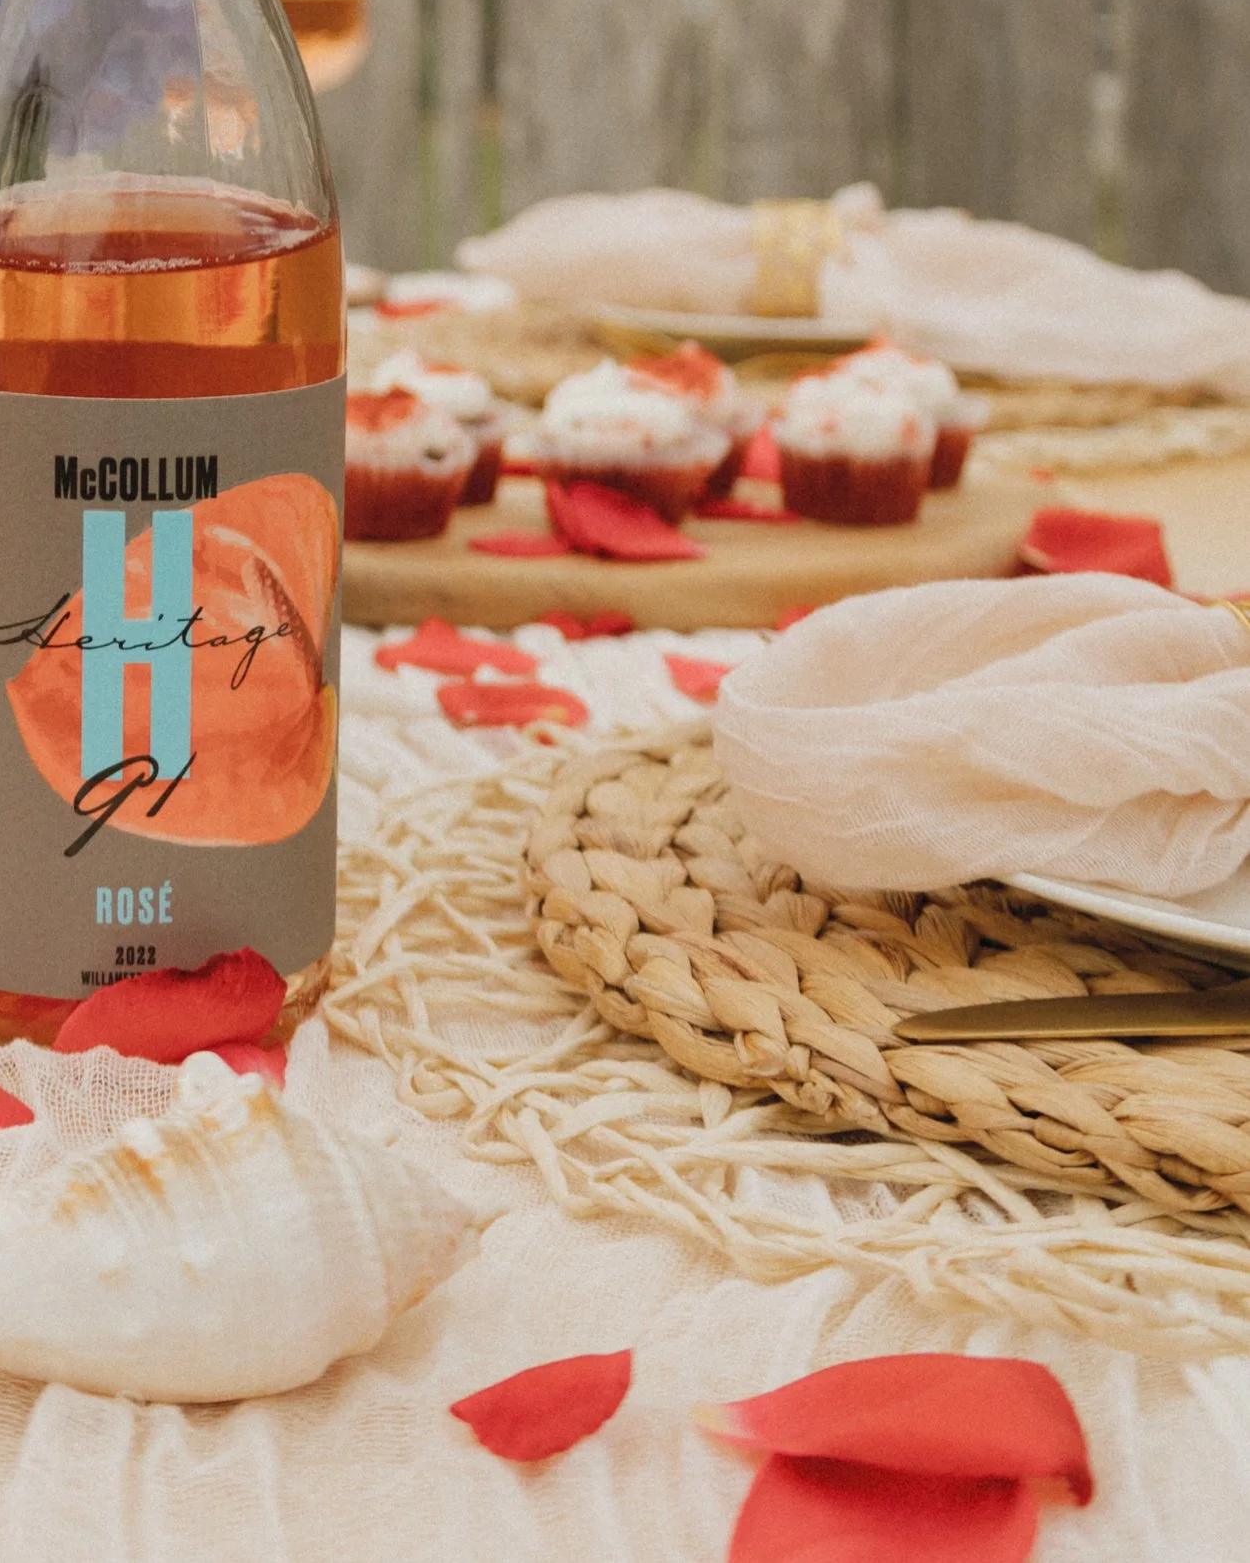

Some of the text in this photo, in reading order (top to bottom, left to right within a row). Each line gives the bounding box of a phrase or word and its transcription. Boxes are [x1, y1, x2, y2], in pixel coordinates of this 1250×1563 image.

[54, 455, 218, 501] McCOLLUM
[81, 510, 193, 780] H
[63, 751, 197, 857] 91
[96, 880, 173, 924] ROSÉ
[81, 970, 142, 986] WILLAM
[115, 945, 156, 966] 2022
